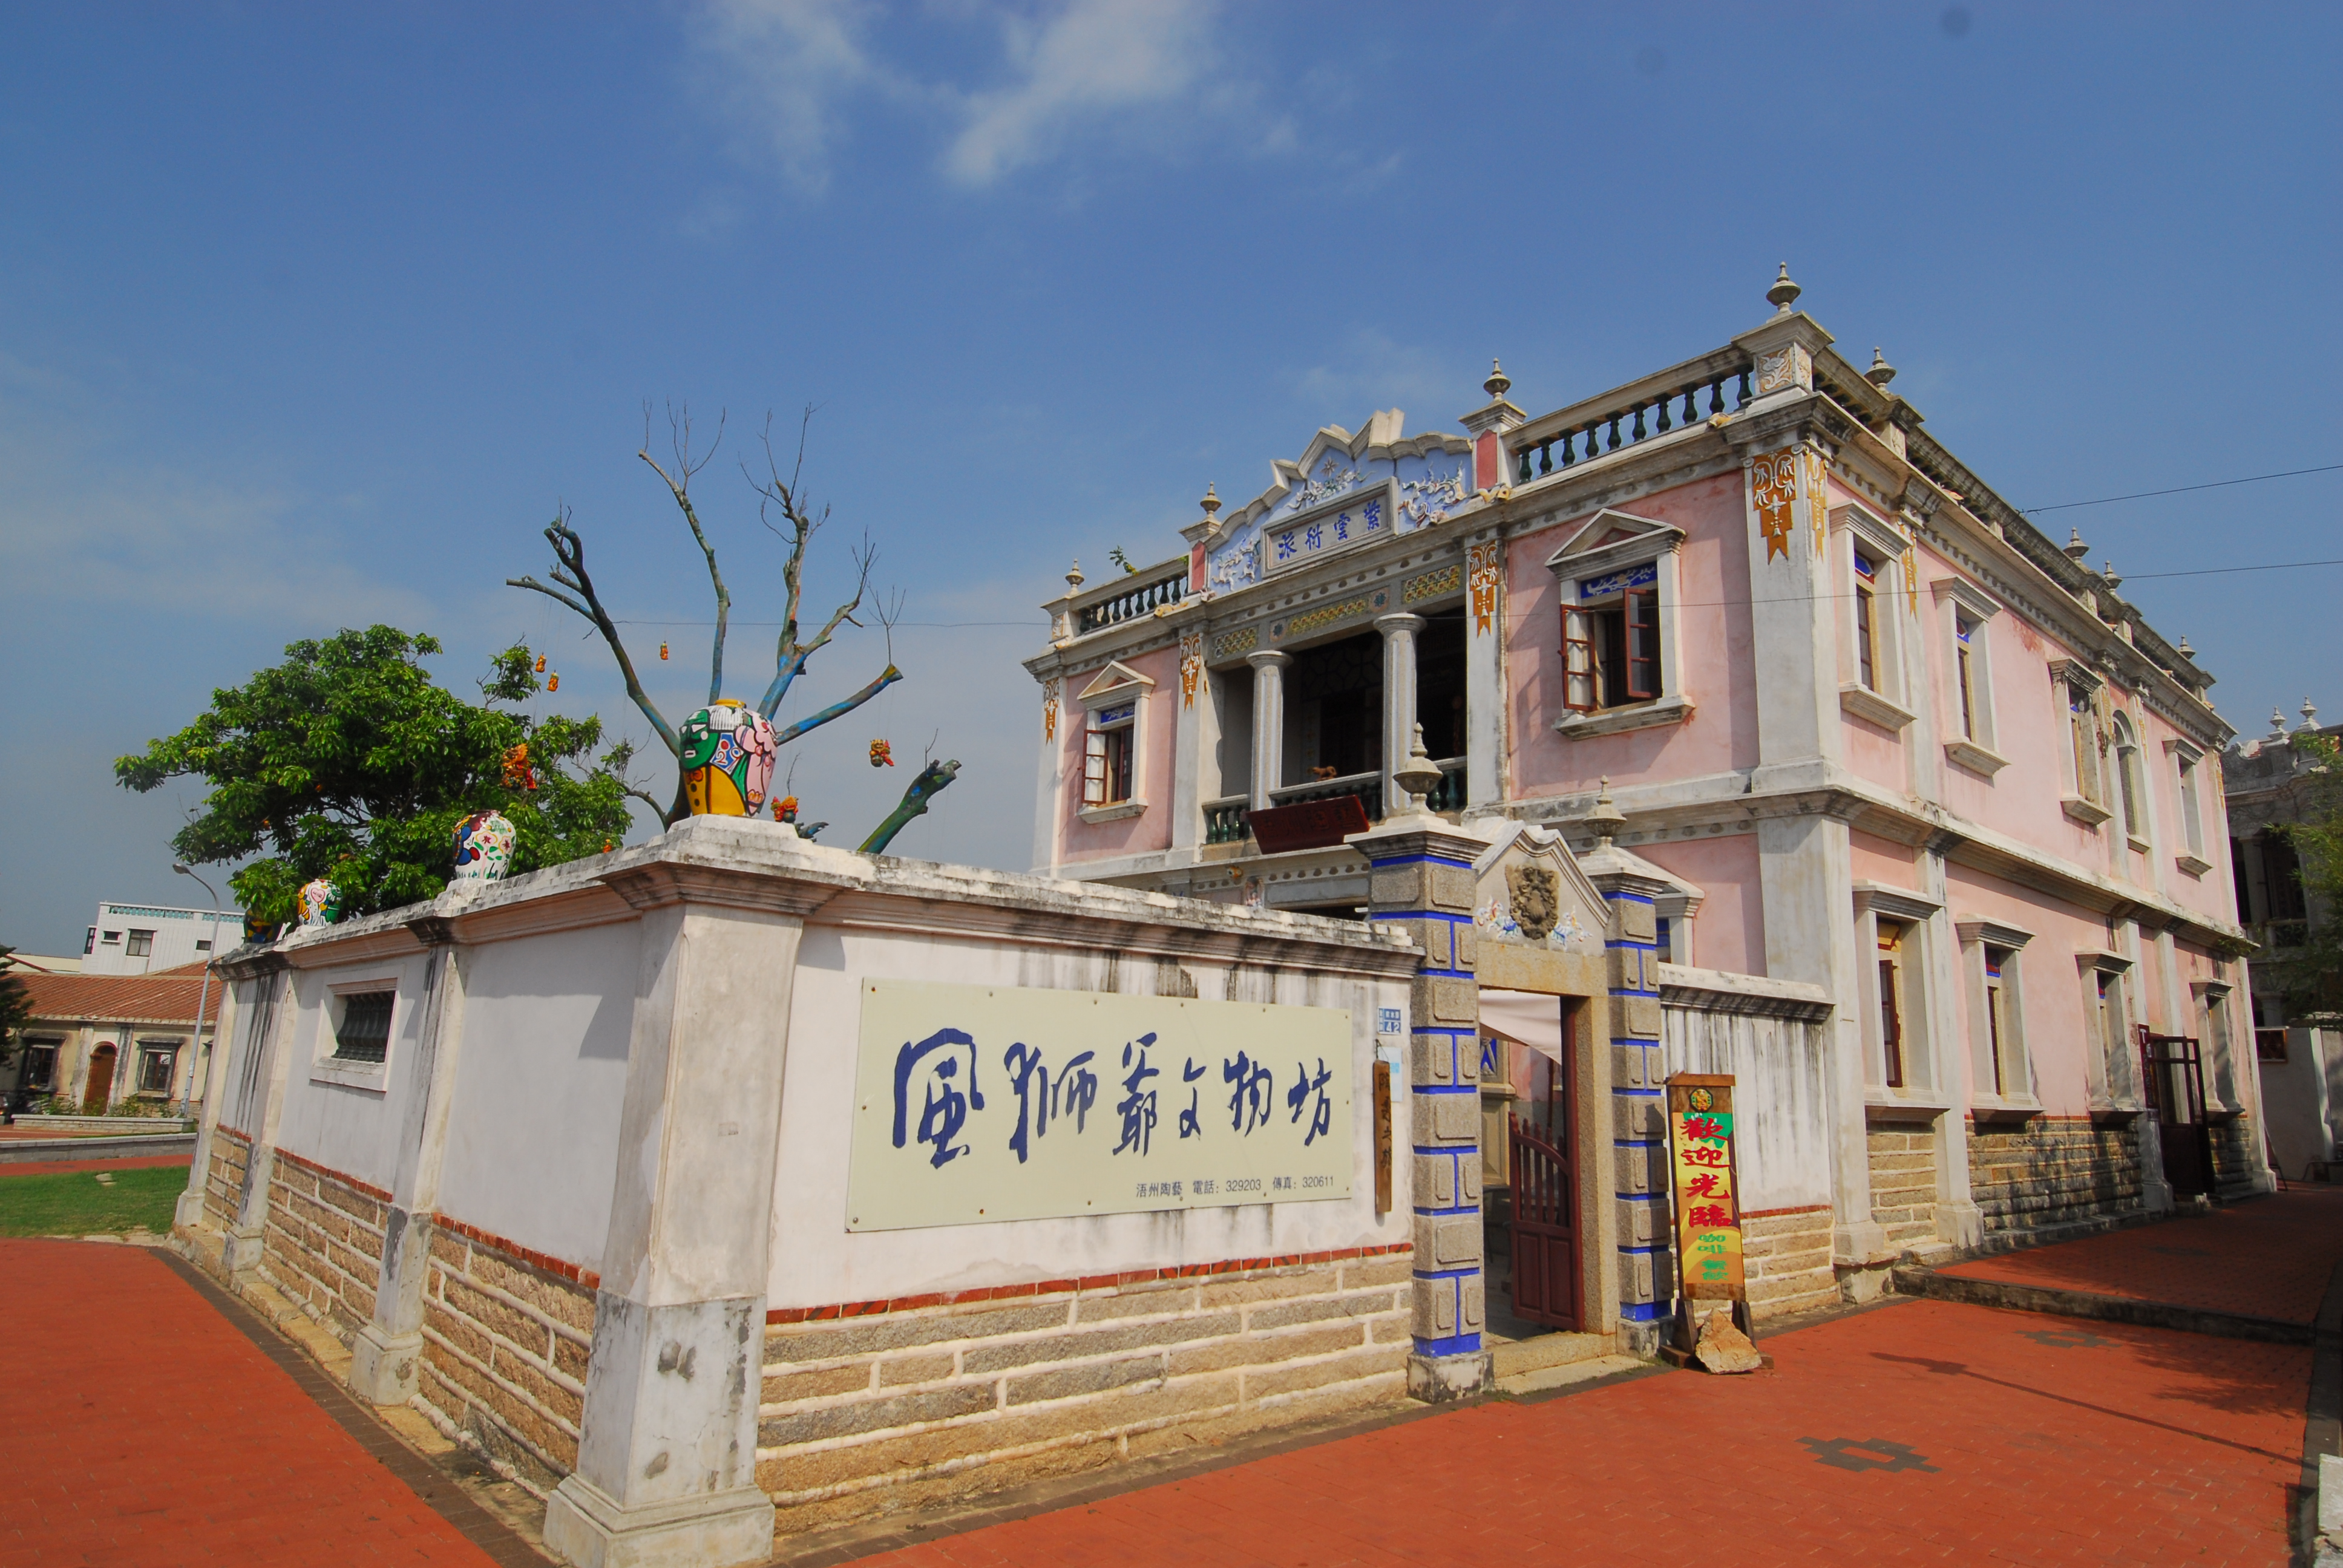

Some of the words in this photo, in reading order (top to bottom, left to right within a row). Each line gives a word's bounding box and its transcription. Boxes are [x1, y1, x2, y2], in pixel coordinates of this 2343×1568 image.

[1386, 1021, 1400, 1033] 42
[893, 1028, 1332, 1169] 風獅爺文物坊
[1136, 1181, 1182, 1198] 浯州陶藝
[1680, 1117, 1732, 1227] 歡迎光臨
